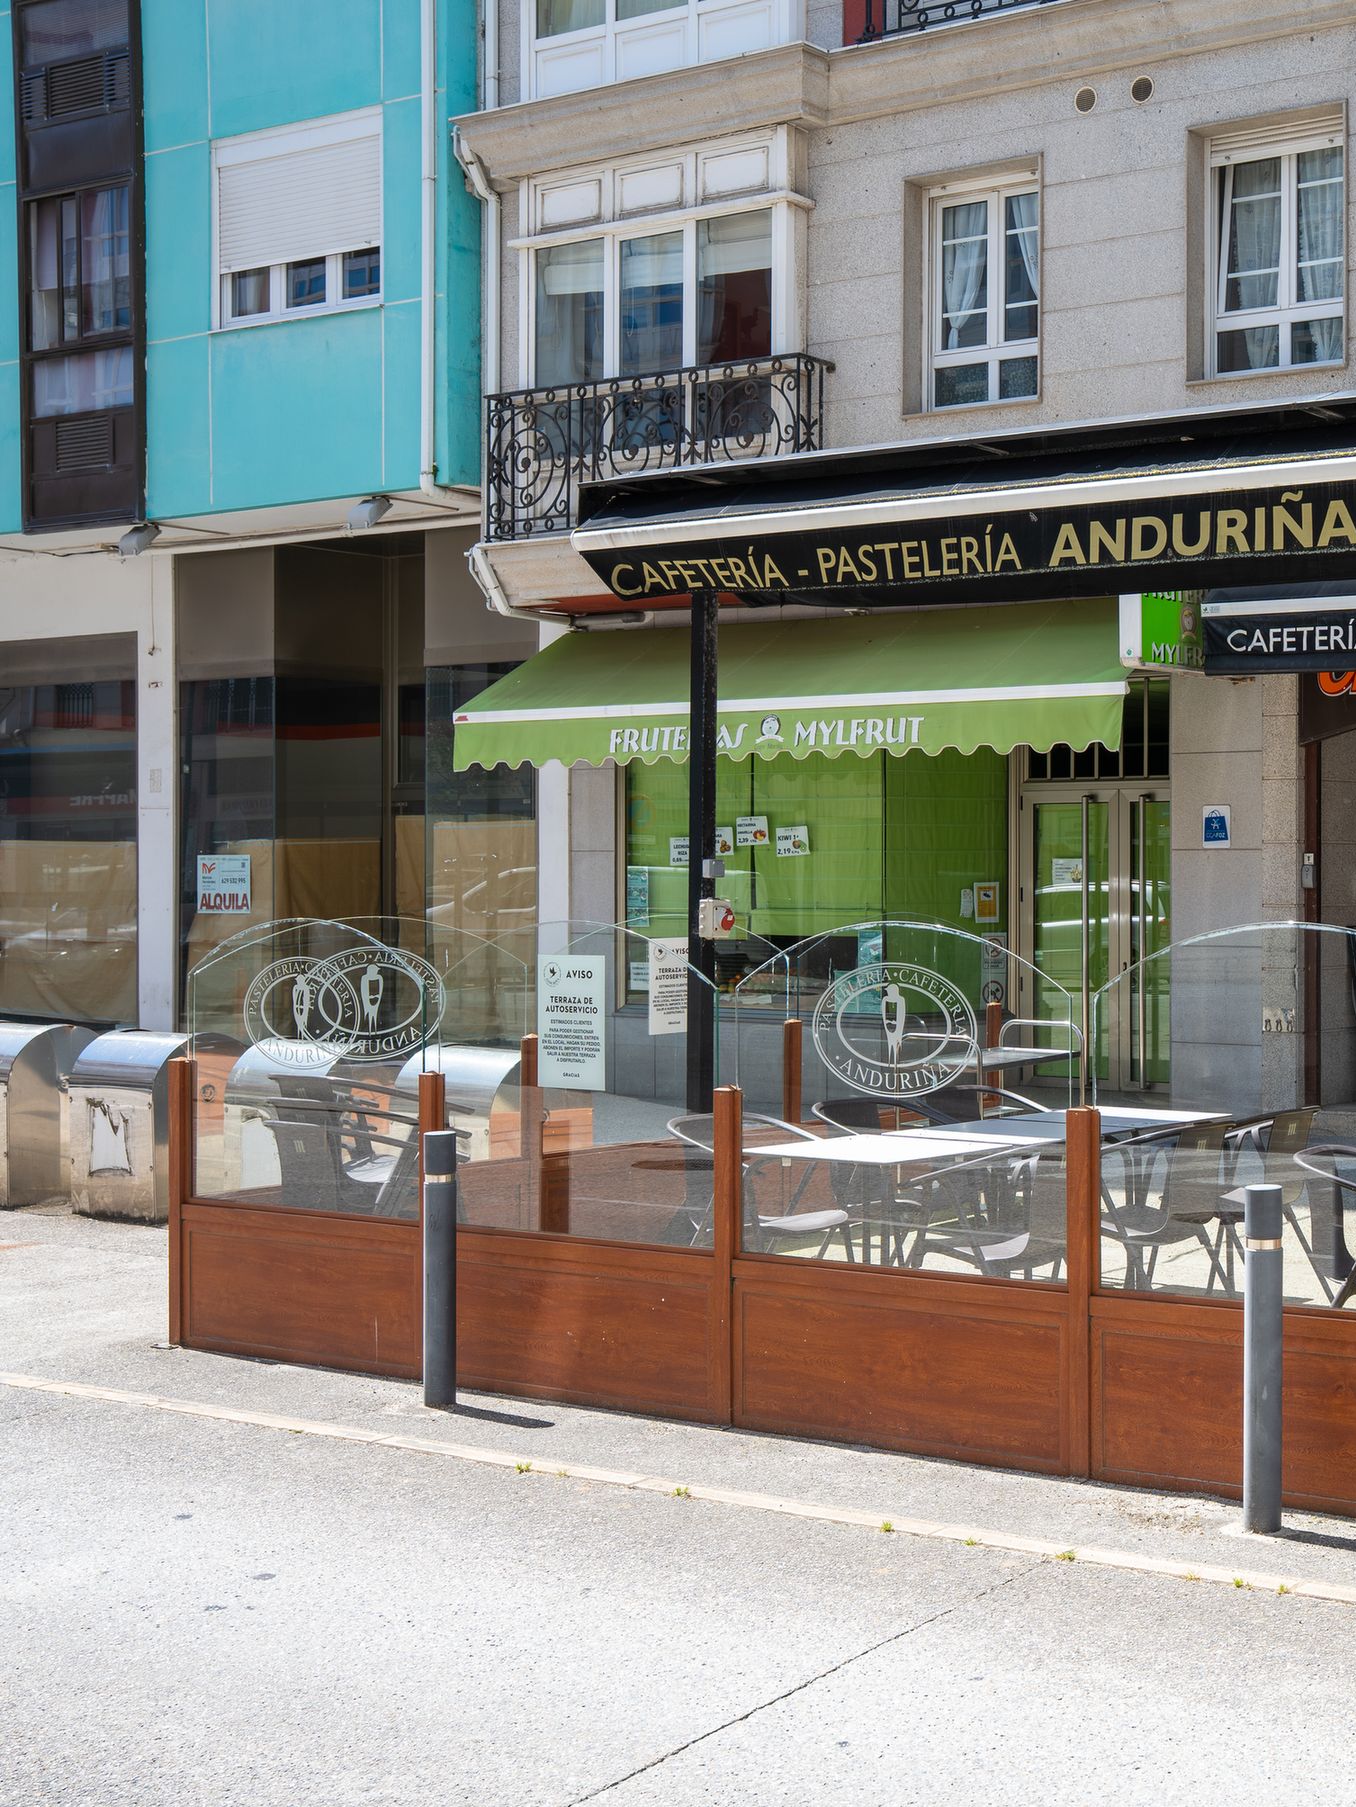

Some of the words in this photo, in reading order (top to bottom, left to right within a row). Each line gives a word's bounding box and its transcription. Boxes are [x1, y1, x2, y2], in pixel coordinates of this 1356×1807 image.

[610, 546, 790, 596] CAFETERÍA
[816, 524, 1022, 583] PASTELERÍA
[609, 722, 749, 753] FRUTEAS
[794, 717, 925, 747] MYLFRUT
[778, 834, 793, 842] KIWI
[200, 893, 249, 911] ALQUILA
[566, 970, 593, 979] AVISO
[655, 973, 688, 981] AUTOSERVIC
[249, 961, 301, 1016] PASTELERIA
[550, 995, 582, 1005] TERRAZA
[584, 997, 593, 1005] DE
[820, 969, 892, 1031] PASTELERIA
[899, 969, 967, 1036] CAFETERIA
[545, 1005, 599, 1015] AUTOSERVICIO
[839, 1058, 953, 1090] ANDURIÑA
